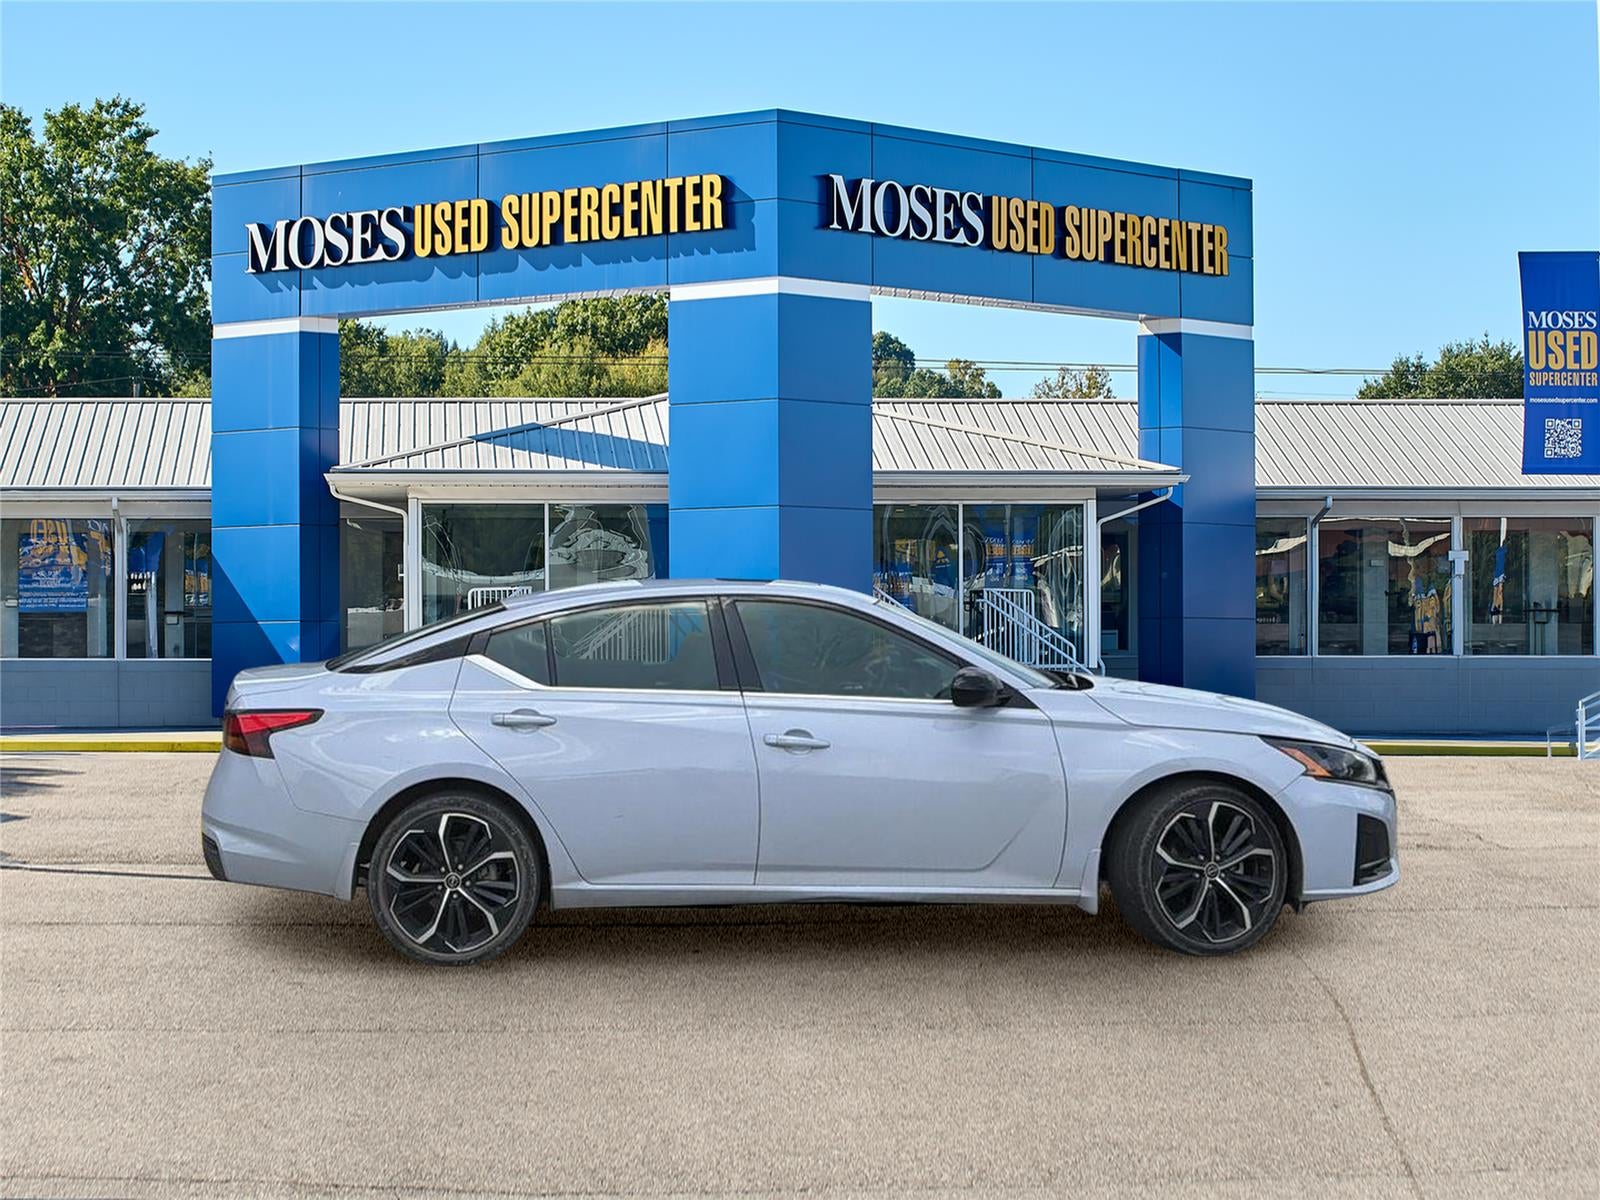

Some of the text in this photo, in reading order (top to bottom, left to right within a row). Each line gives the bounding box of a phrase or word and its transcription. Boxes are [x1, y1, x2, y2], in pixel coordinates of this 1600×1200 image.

[244, 174, 724, 273] MOSES USED SUPERCENTER
[829, 173, 1229, 276] MOSES USED SUPERCENTER
[1528, 311, 1597, 329] MOSES
[1528, 330, 1598, 370] USED
[1529, 372, 1598, 387] SUPERCENTER
